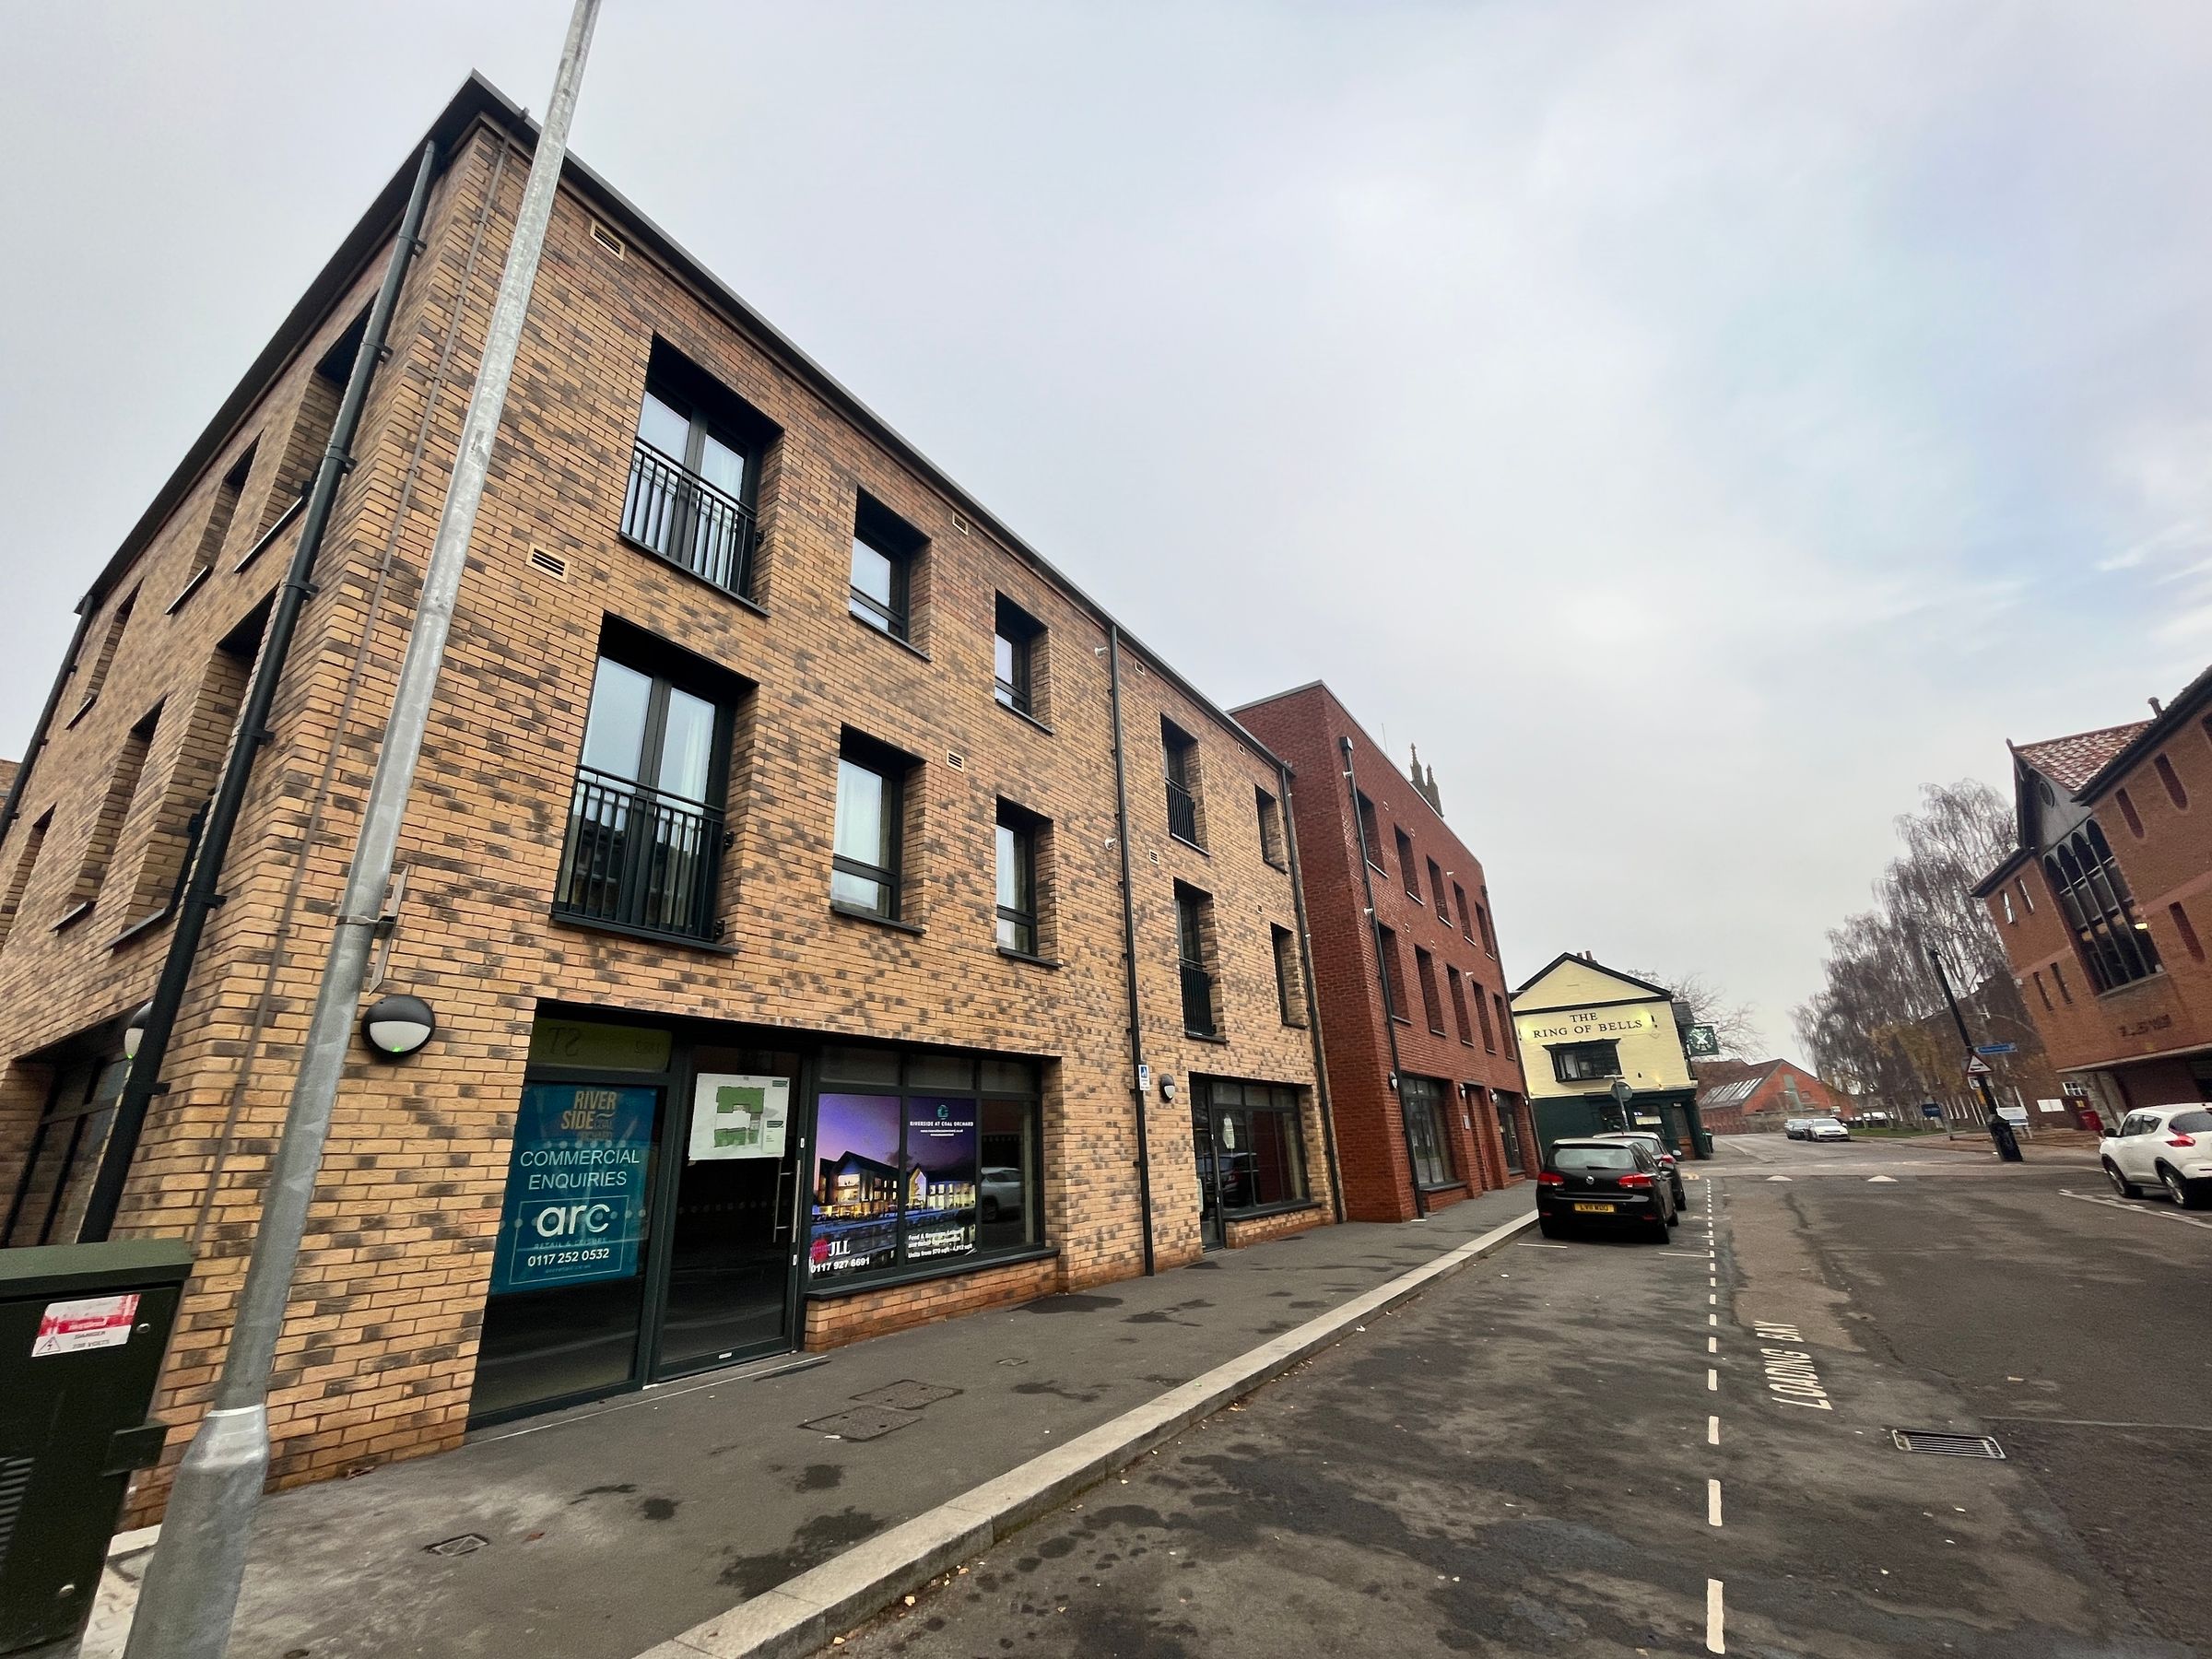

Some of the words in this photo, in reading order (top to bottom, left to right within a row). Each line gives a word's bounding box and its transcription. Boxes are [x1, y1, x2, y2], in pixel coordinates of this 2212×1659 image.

[1570, 1013, 1598, 1023] THE
[1533, 1028, 1568, 1038] RING
[1574, 1025, 1592, 1034] OF
[1598, 1019, 1642, 1032] BELLS
[573, 1090, 618, 1111] RIVER
[560, 1110, 596, 1130] SIDE
[520, 1149, 640, 1167] COMMERCIAL
[528, 1171, 627, 1190] ENQUIRIES
[536, 1204, 610, 1238] arc
[527, 1253, 556, 1267] 0117
[557, 1251, 579, 1264] 252
[582, 1248, 610, 1261] 0532
[828, 1240, 851, 1257] JLL
[811, 1262, 831, 1274] 0117
[833, 1260, 849, 1270] 927
[851, 1256, 870, 1267] 6691
[1753, 1320, 1805, 1343] BAY
[1759, 1347, 1833, 1410] LOADING
